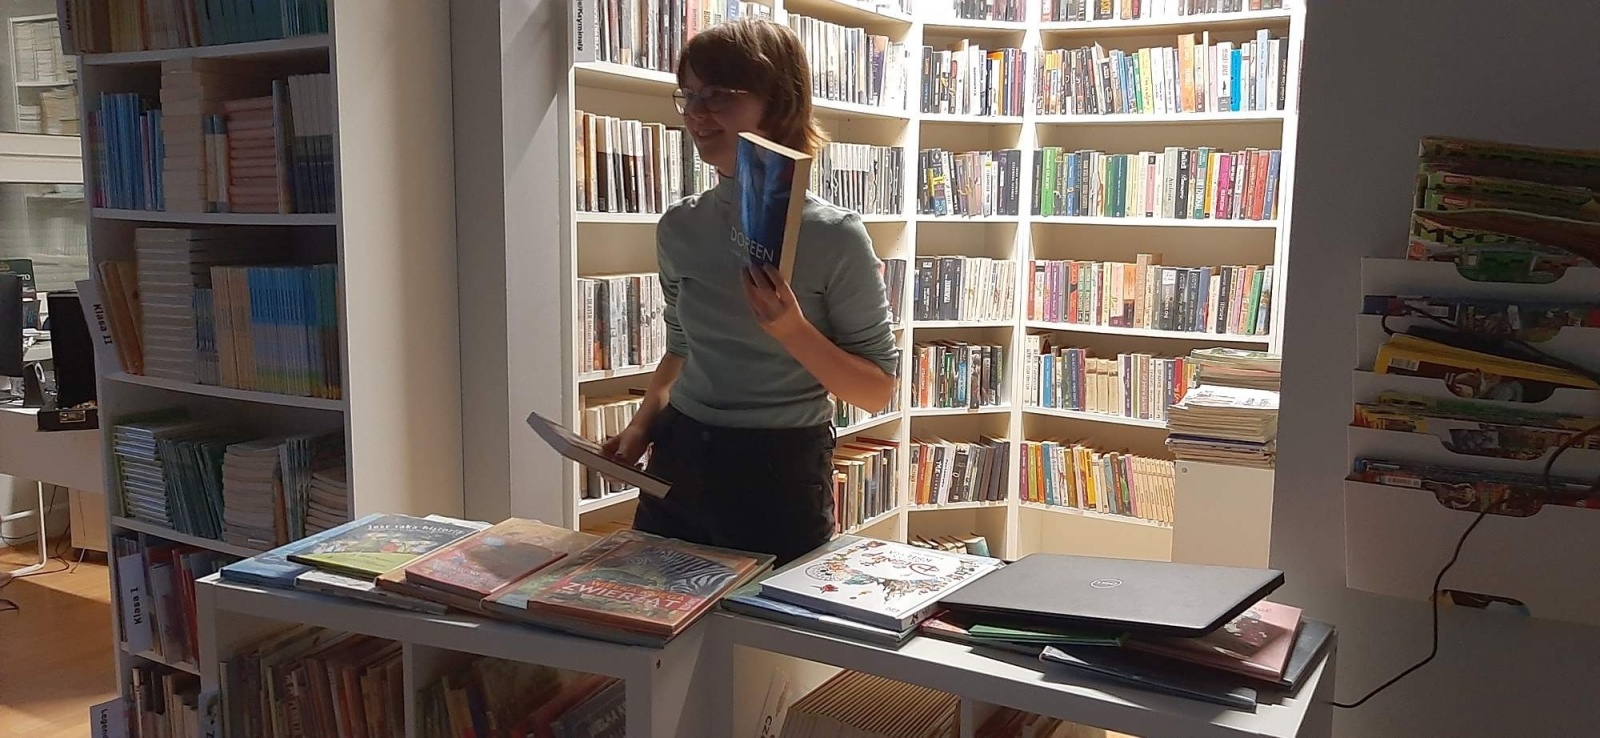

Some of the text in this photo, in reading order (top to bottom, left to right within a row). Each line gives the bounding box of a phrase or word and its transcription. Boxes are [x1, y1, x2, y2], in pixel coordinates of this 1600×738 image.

[731, 226, 775, 263] DOREEN
[93, 303, 113, 345] Klasa II
[134, 596, 143, 626] Klasa
